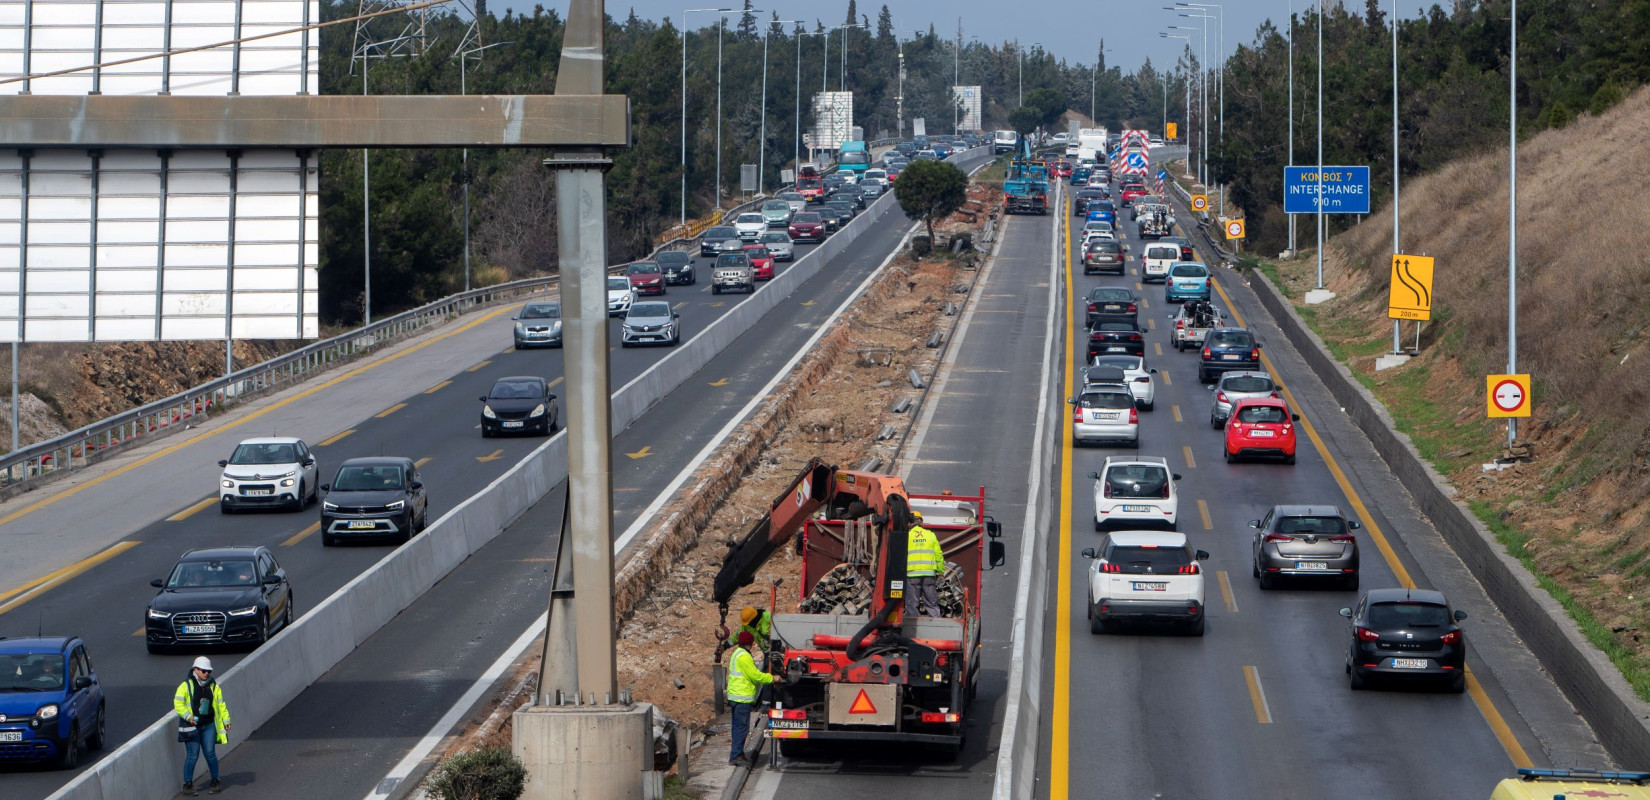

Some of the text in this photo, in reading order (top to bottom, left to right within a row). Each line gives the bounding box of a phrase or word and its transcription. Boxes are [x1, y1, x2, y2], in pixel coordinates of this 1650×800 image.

[1346, 173, 1353, 182] 7
[1290, 185, 1363, 194] INTERCHANGE
[4, 732, 21, 741] 1636
